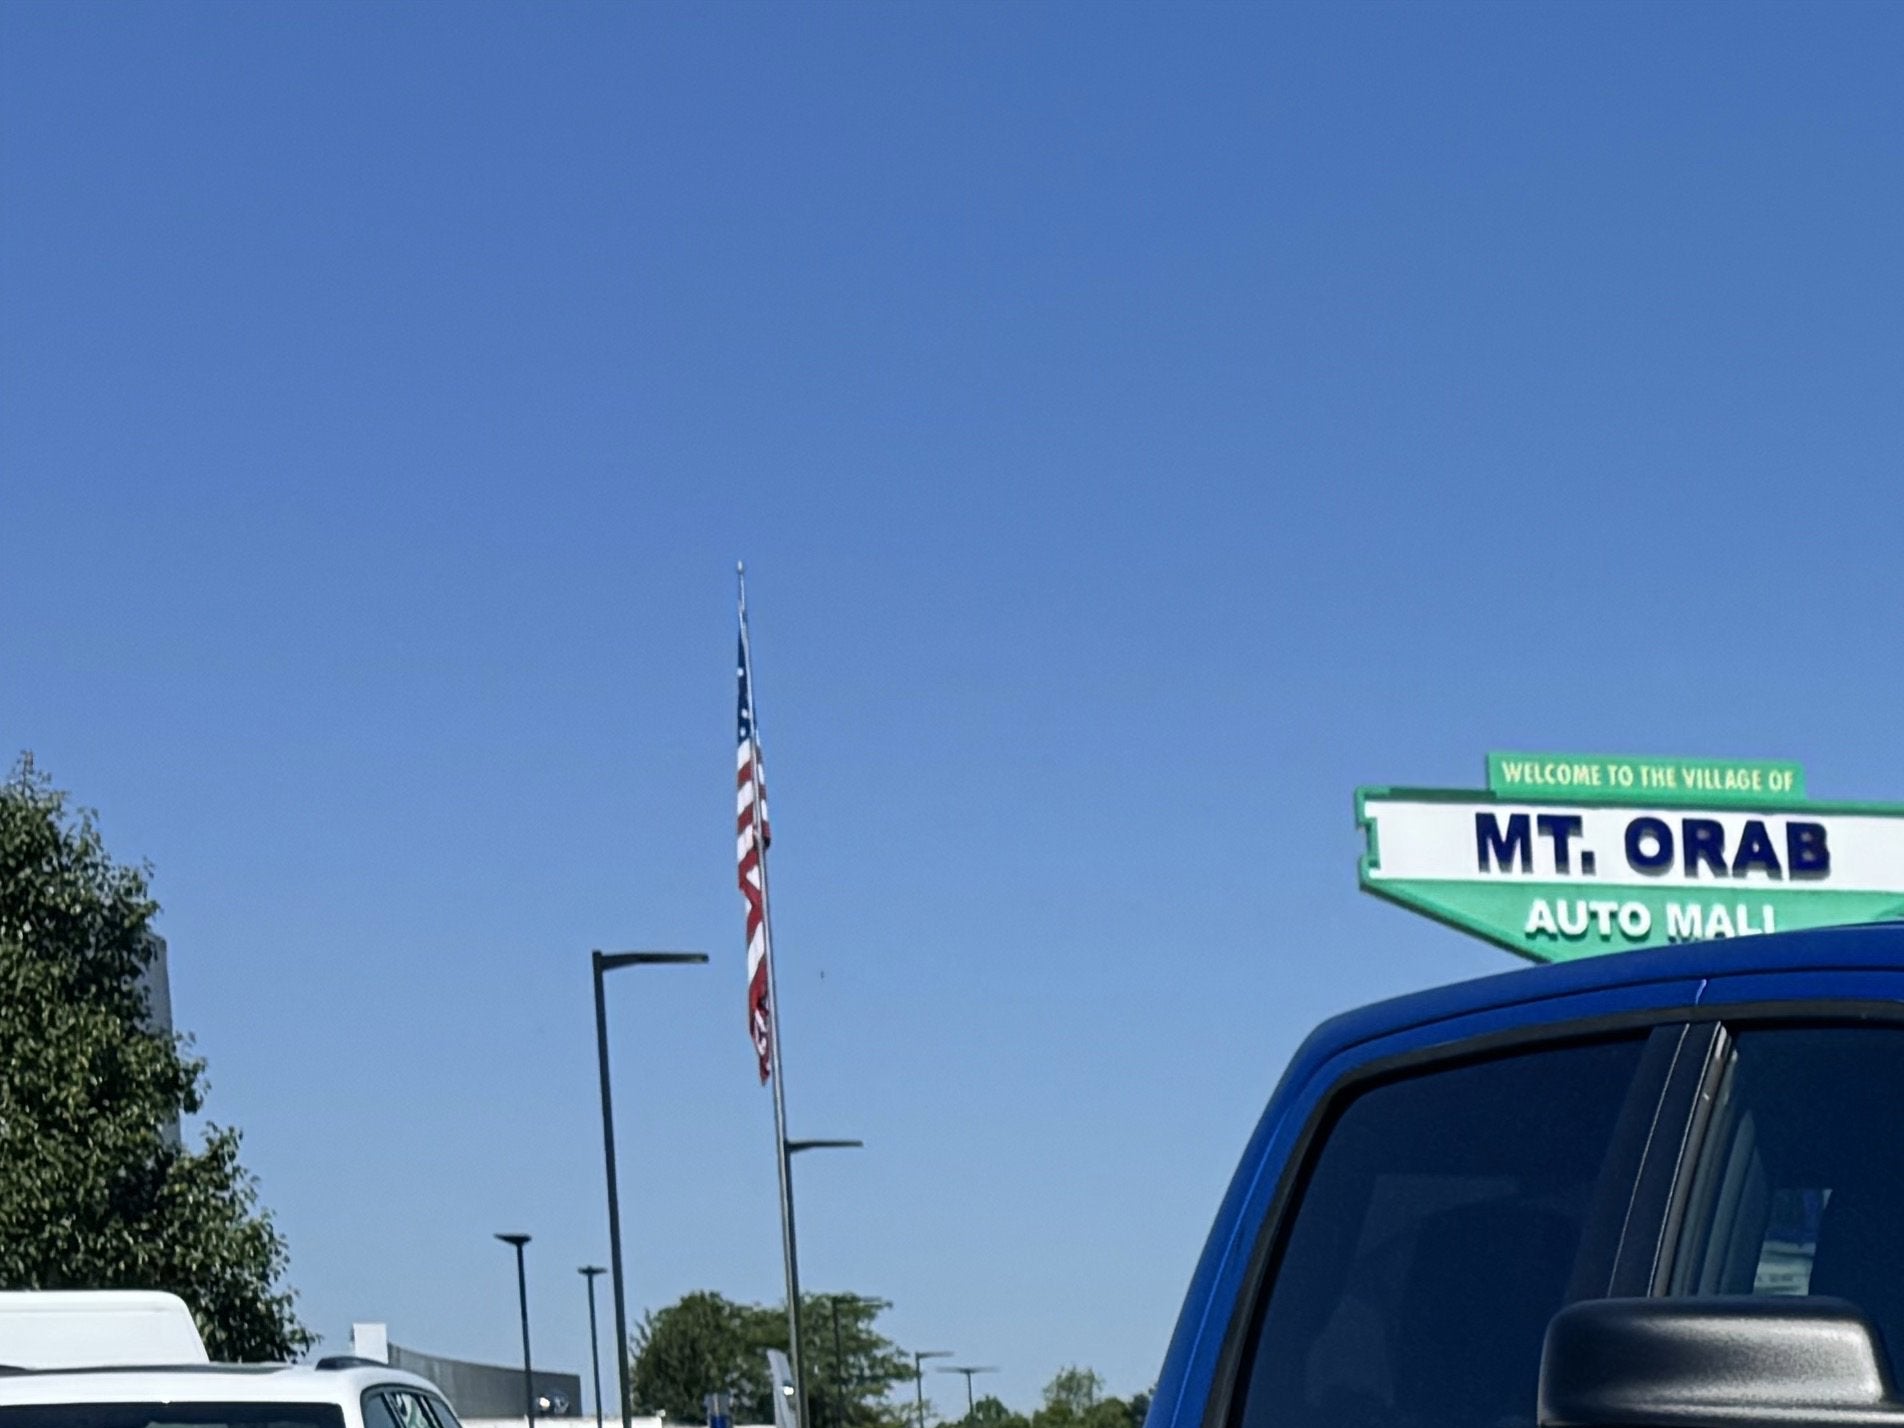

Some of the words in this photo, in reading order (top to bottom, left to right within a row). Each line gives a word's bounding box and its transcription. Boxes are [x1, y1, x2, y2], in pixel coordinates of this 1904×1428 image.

[1501, 761, 1600, 786] WELCOME
[1607, 765, 1634, 787] TO
[1640, 765, 1677, 788] THE
[1682, 766, 1762, 790] VILLAGE
[1768, 769, 1795, 792] OF
[1474, 812, 1596, 876] MT.
[1624, 815, 1832, 881] ORAB
[1525, 898, 1652, 941] AUTO
